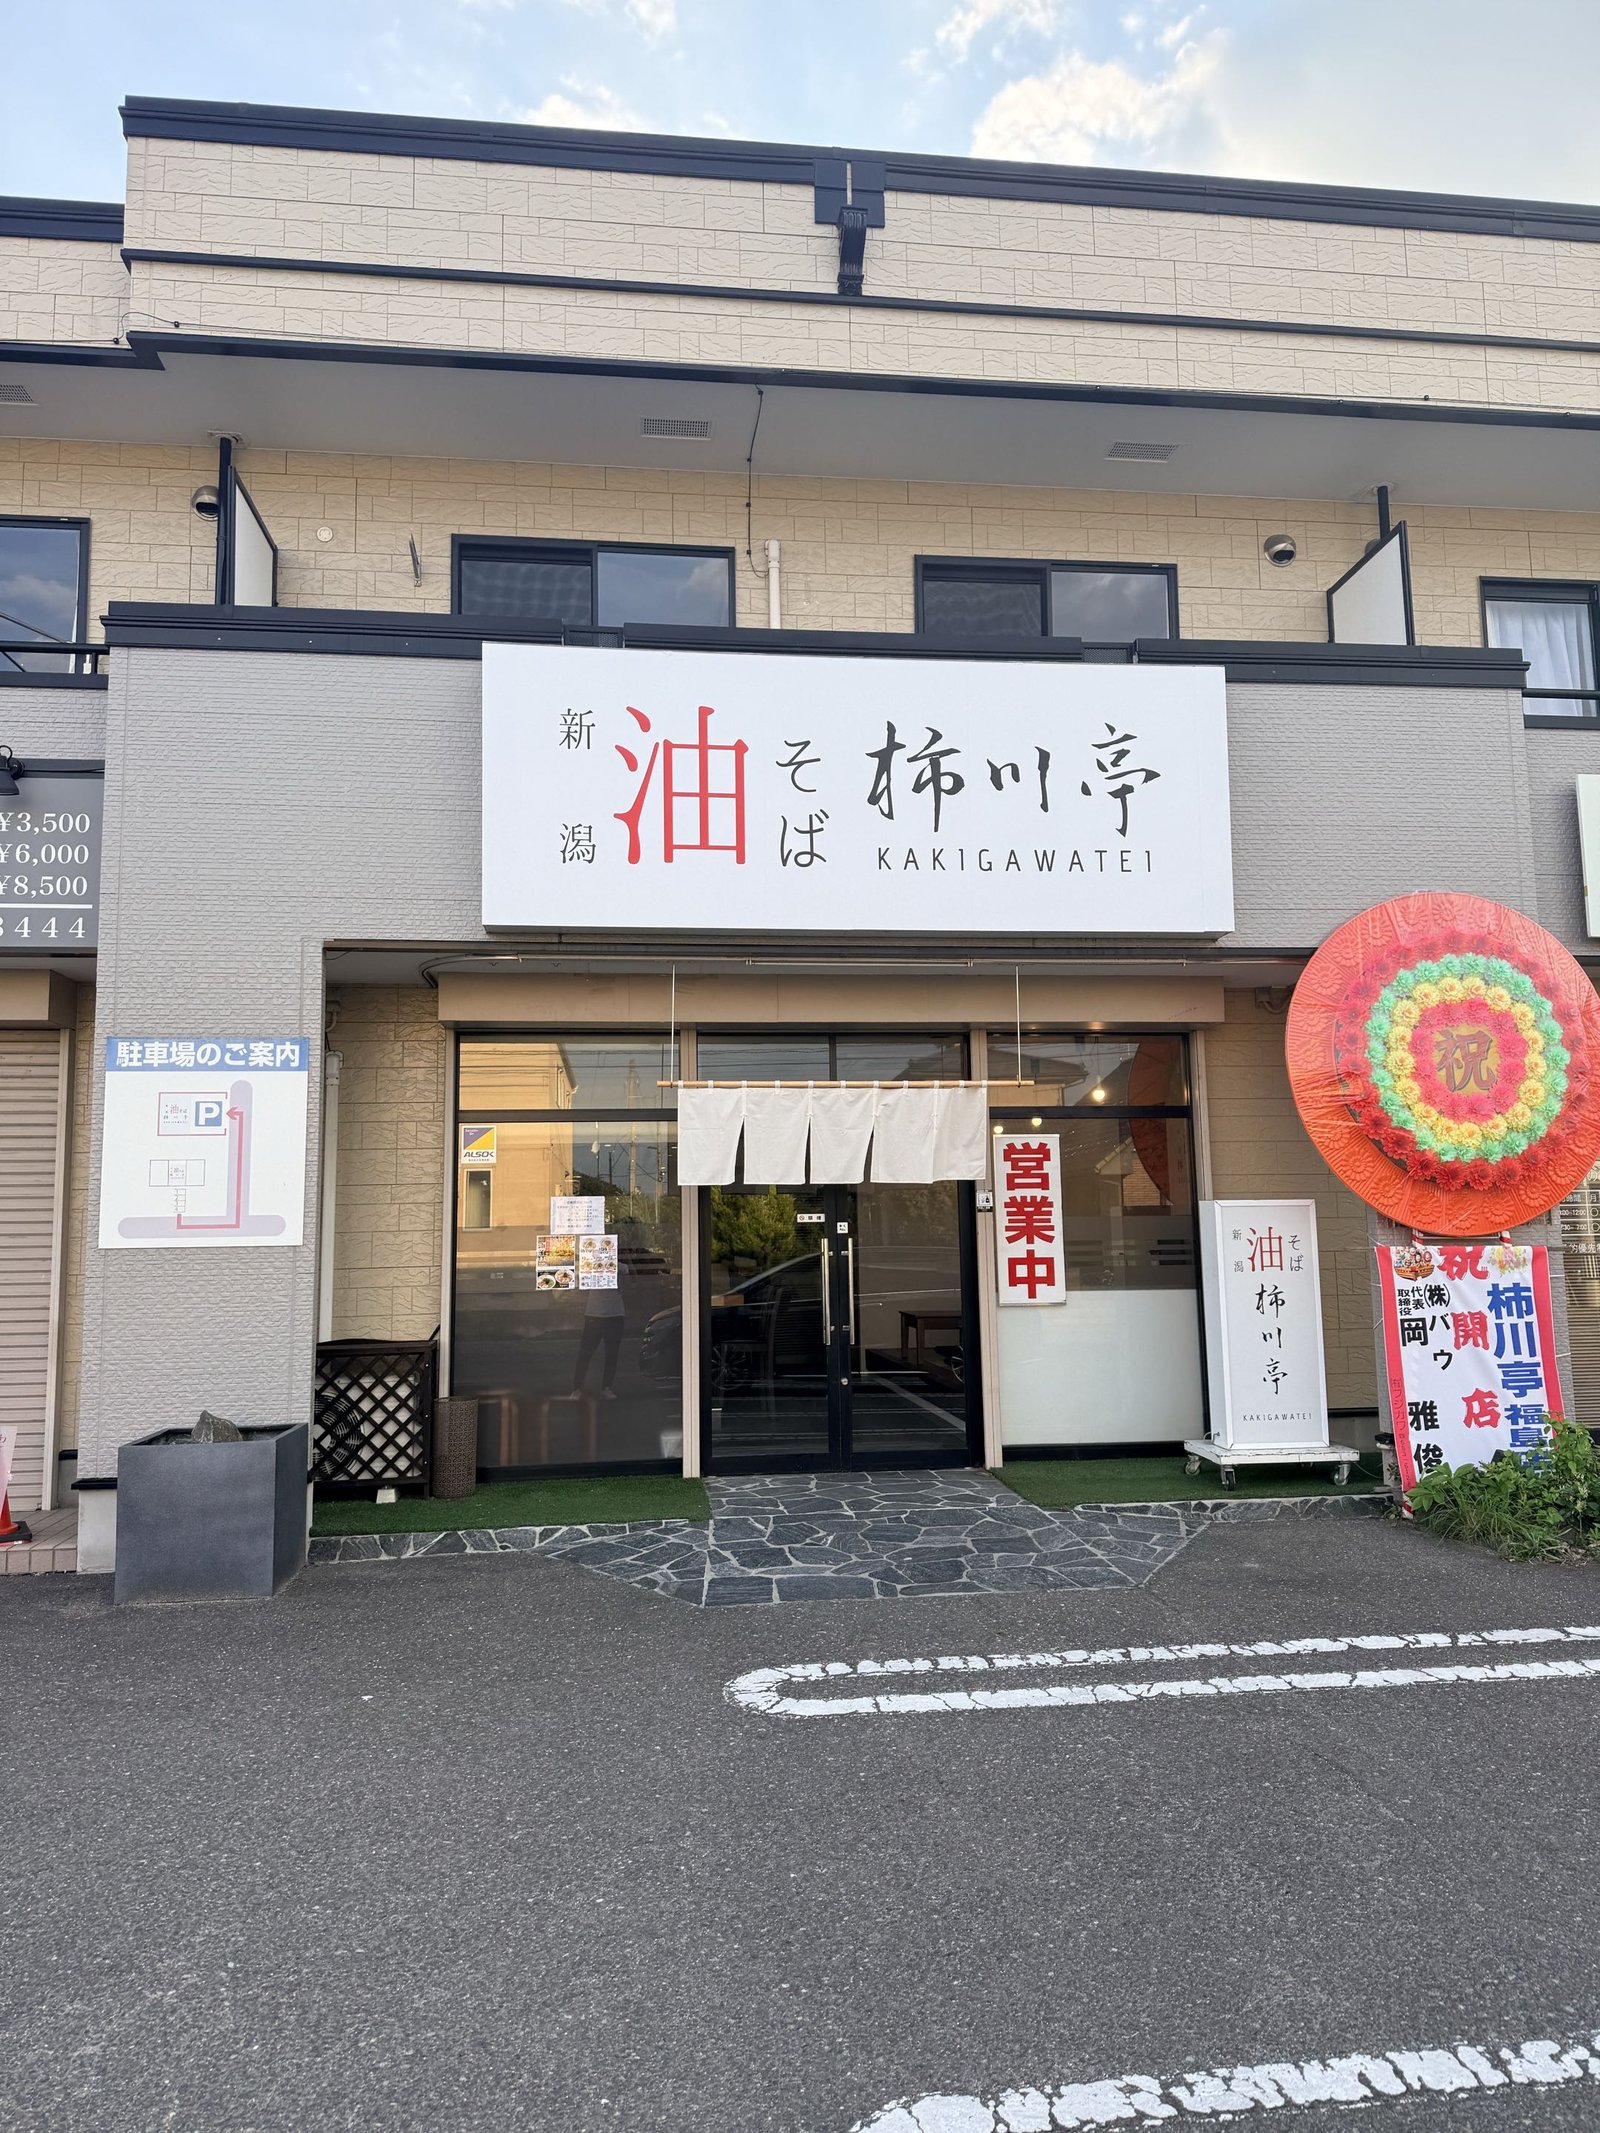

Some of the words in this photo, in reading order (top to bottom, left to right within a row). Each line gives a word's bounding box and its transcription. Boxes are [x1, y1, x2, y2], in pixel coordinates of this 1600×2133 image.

[560, 708, 596, 864] 新潟
[614, 706, 748, 865] 油
[775, 740, 830, 868] そば
[865, 720, 1161, 838] 柿川亭
[0, 812, 90, 834] ¥3,500
[0, 843, 89, 866] ¥6,000
[878, 848, 1151, 873] KAKIGAWATEI
[116, 1041, 300, 1068] 駐車場のご案内
[1436, 1029, 1498, 1092] 祝
[199, 1103, 220, 1125] P
[1003, 1141, 1056, 1299] 営業中
[1247, 1226, 1284, 1272] 油
[1288, 1234, 1304, 1272] そば
[1410, 1286, 1425, 1310] 代表
[1255, 1283, 1288, 1395] 柿川亭
[1243, 1412, 1312, 1422] KAKIGAWATEI
